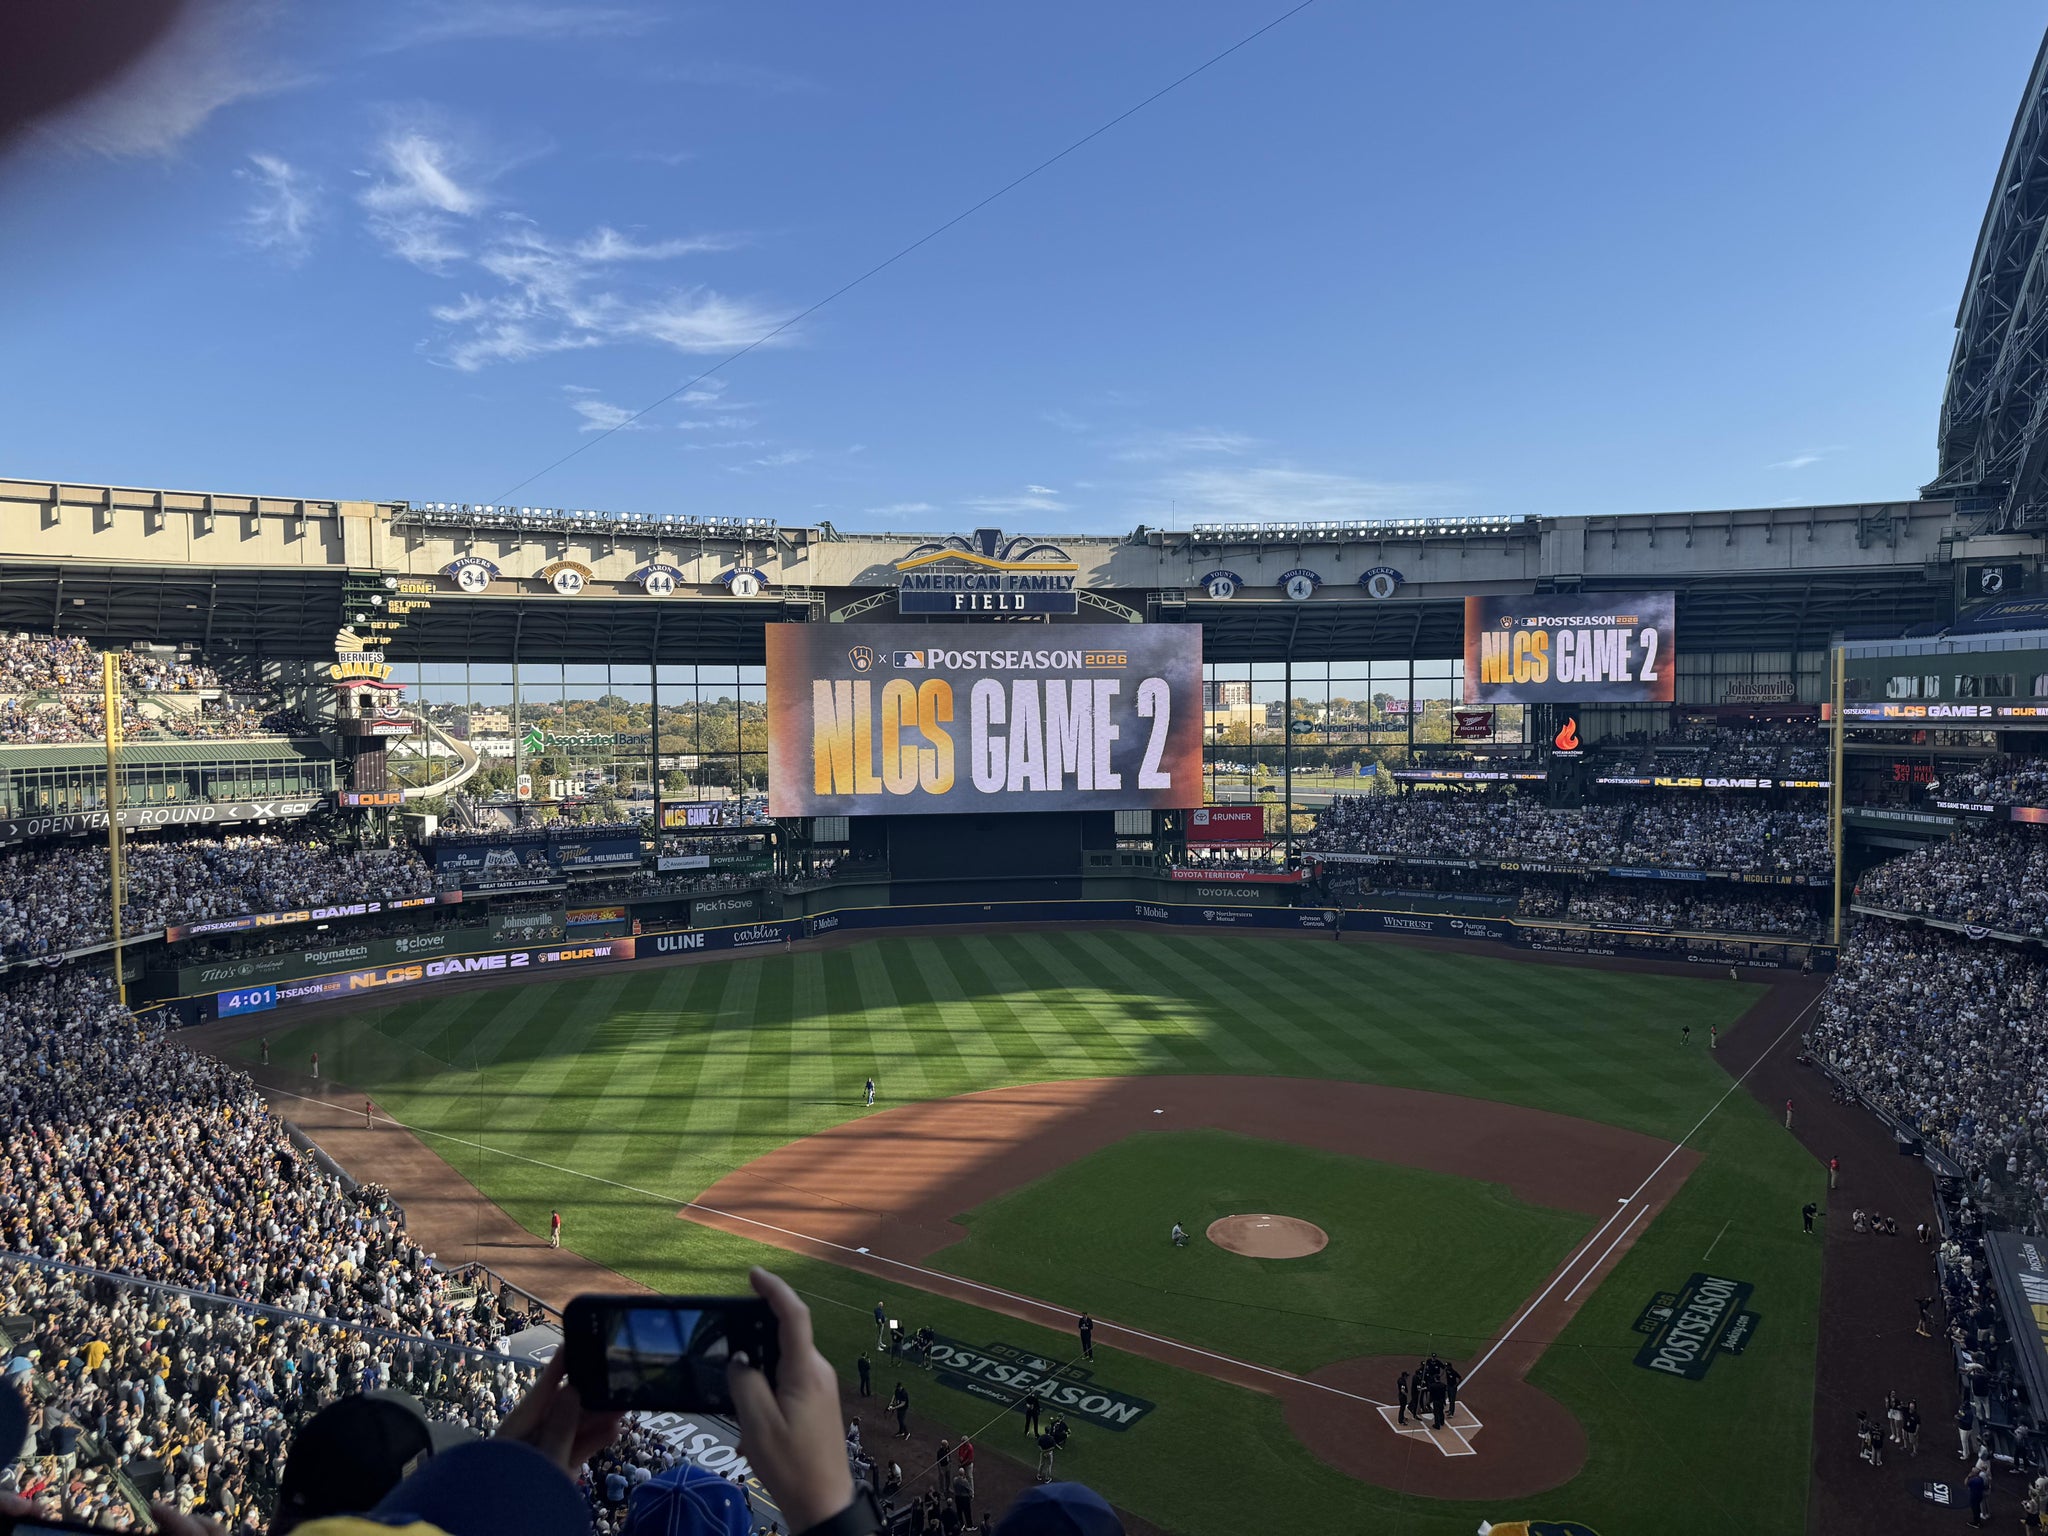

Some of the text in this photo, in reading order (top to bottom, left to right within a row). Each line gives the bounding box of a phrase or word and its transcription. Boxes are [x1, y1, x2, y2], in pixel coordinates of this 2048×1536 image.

[457, 557, 491, 568] FINGERS
[648, 565, 673, 573] AARON
[734, 567, 756, 575] SELIG
[1210, 571, 1233, 579] YOUNT
[1284, 569, 1316, 580] MOLITOR
[1367, 568, 1394, 576] UECKER
[462, 569, 488, 587] 34
[557, 572, 581, 589] 42
[649, 577, 672, 592] 44
[902, 574, 1075, 591] AMERICAN FAMILY
[400, 584, 436, 593] GONE!
[741, 579, 751, 595] 1
[1213, 582, 1230, 596] 19
[1293, 581, 1303, 595] 4
[955, 595, 1025, 610] FIELD
[1538, 615, 1615, 626] POSTSEASON
[340, 653, 384, 662] BERNIE'S
[928, 648, 1083, 669] POSTSEASON
[1481, 628, 1658, 684] NLCS GAME 2
[330, 663, 393, 681] CHALET
[1726, 680, 1795, 696] Johnsonville
[1884, 706, 1992, 717] NLCS GAME 2
[2012, 707, 2036, 715] OUR
[1317, 723, 1407, 732] Aurora Health Care
[812, 677, 1171, 796] NLCS GAME 2
[1654, 778, 1702, 787] NLCS
[1704, 778, 1757, 788] GAME
[1759, 780, 1772, 788] 2
[359, 794, 400, 804] OUR
[281, 802, 329, 815] GOLF
[28, 817, 75, 834] OPEN
[139, 807, 215, 824] ROUND
[664, 808, 719, 826] NLCS GAME 2
[556, 847, 592, 863] Miller
[594, 853, 633, 862] MILWAUKEE
[1521, 863, 1551, 872] WTMJ
[1173, 871, 1203, 879] TOYOTA
[1660, 870, 1701, 879] WINTRUST
[1743, 875, 1792, 884] NICOLET LAW
[1197, 888, 1259, 897] TOYOTA.COM
[402, 898, 424, 907] OUR
[728, 900, 753, 909] Save
[197, 920, 237, 933] POSTSEASON
[255, 911, 310, 926] NLCS
[312, 904, 366, 920] GAME
[368, 902, 381, 912] 2
[1144, 907, 1168, 919] Mobile
[502, 913, 552, 930] Johnsonville
[818, 916, 839, 929] Mobile
[1384, 917, 1434, 929] WINTRUST
[1464, 922, 1487, 931] Aurora
[734, 925, 782, 941] carbliss
[1464, 929, 1502, 938] Health Care
[409, 936, 446, 949] clover
[657, 933, 705, 951] ULINE
[304, 946, 368, 963] Polymatech
[560, 949, 594, 961] OUR
[595, 946, 611, 957] WAY
[200, 966, 237, 983] Tito's
[229, 953, 529, 1008] 4:01 NLCS GAME 2
[1650, 1277, 1738, 1375] POSTSEASON
